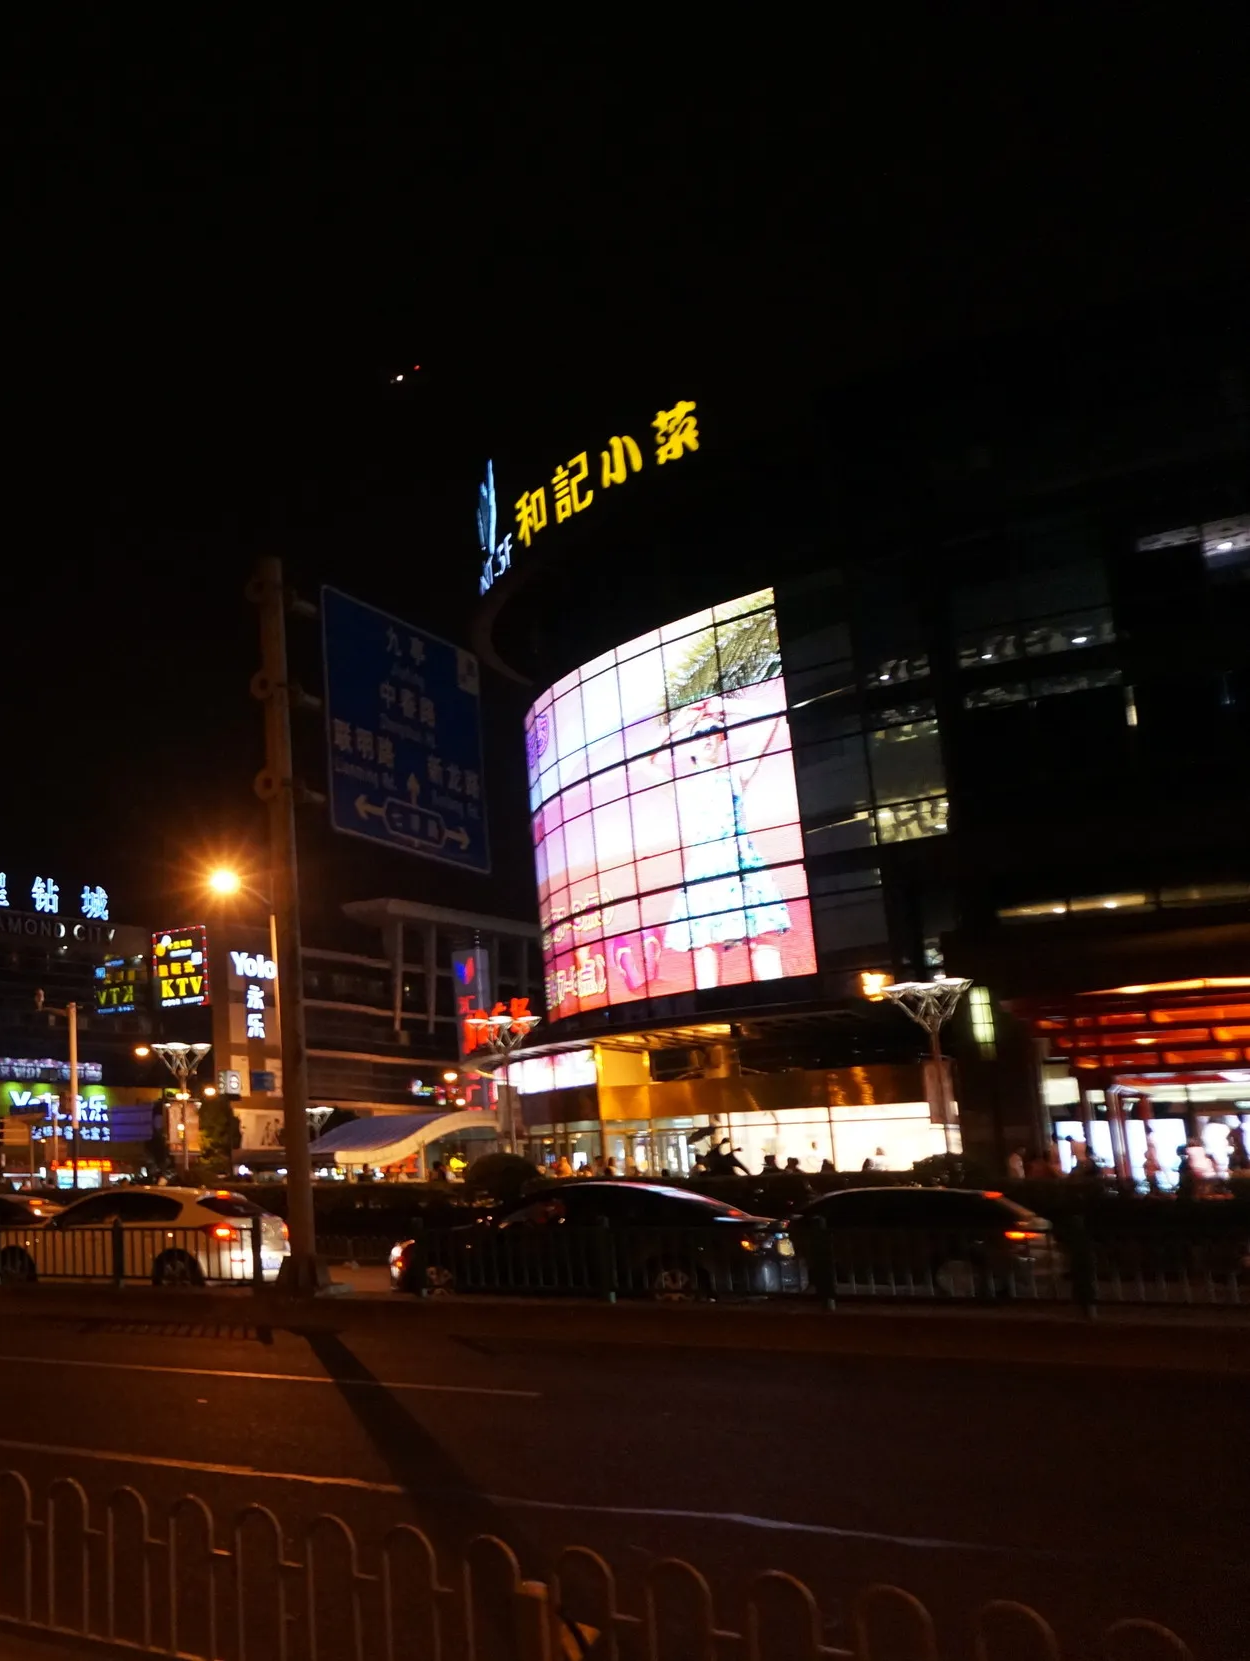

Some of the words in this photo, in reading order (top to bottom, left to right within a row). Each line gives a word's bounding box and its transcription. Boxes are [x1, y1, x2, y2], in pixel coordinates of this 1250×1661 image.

[514, 400, 700, 548] 和記小菜
[72, 923, 116, 944] CITY
[229, 951, 277, 980] Yolo
[161, 976, 204, 998] KTV
[246, 984, 266, 1039] 永乐
